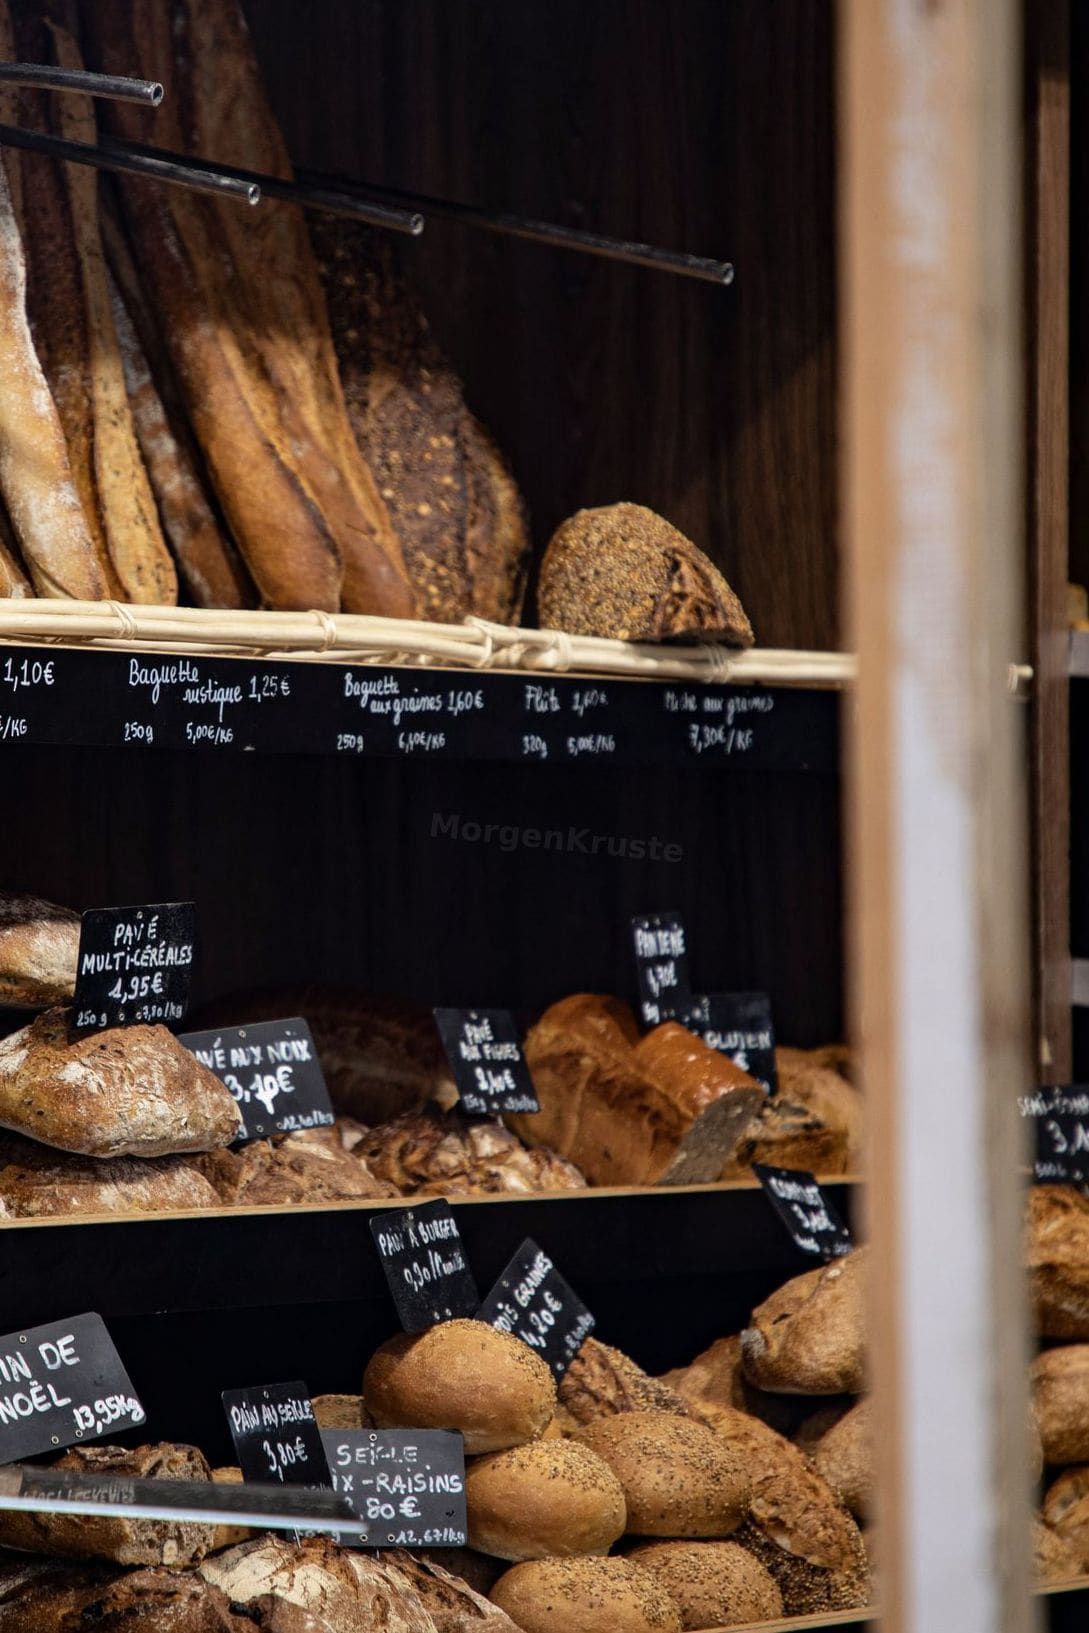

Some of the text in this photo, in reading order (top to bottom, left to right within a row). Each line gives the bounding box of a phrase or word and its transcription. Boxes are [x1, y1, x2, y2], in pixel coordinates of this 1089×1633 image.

[4, 657, 55, 692] 1,10€
[129, 658, 199, 705] Baguette
[344, 672, 400, 707] Baguette
[183, 674, 291, 723] rustique 1,25€
[0, 715, 28, 740] /KG
[124, 722, 234, 745] 250g 5,00€/KG
[337, 734, 364, 753] 250g
[108, 971, 164, 1005] 1,95€
[38, 1334, 80, 1370] DE
